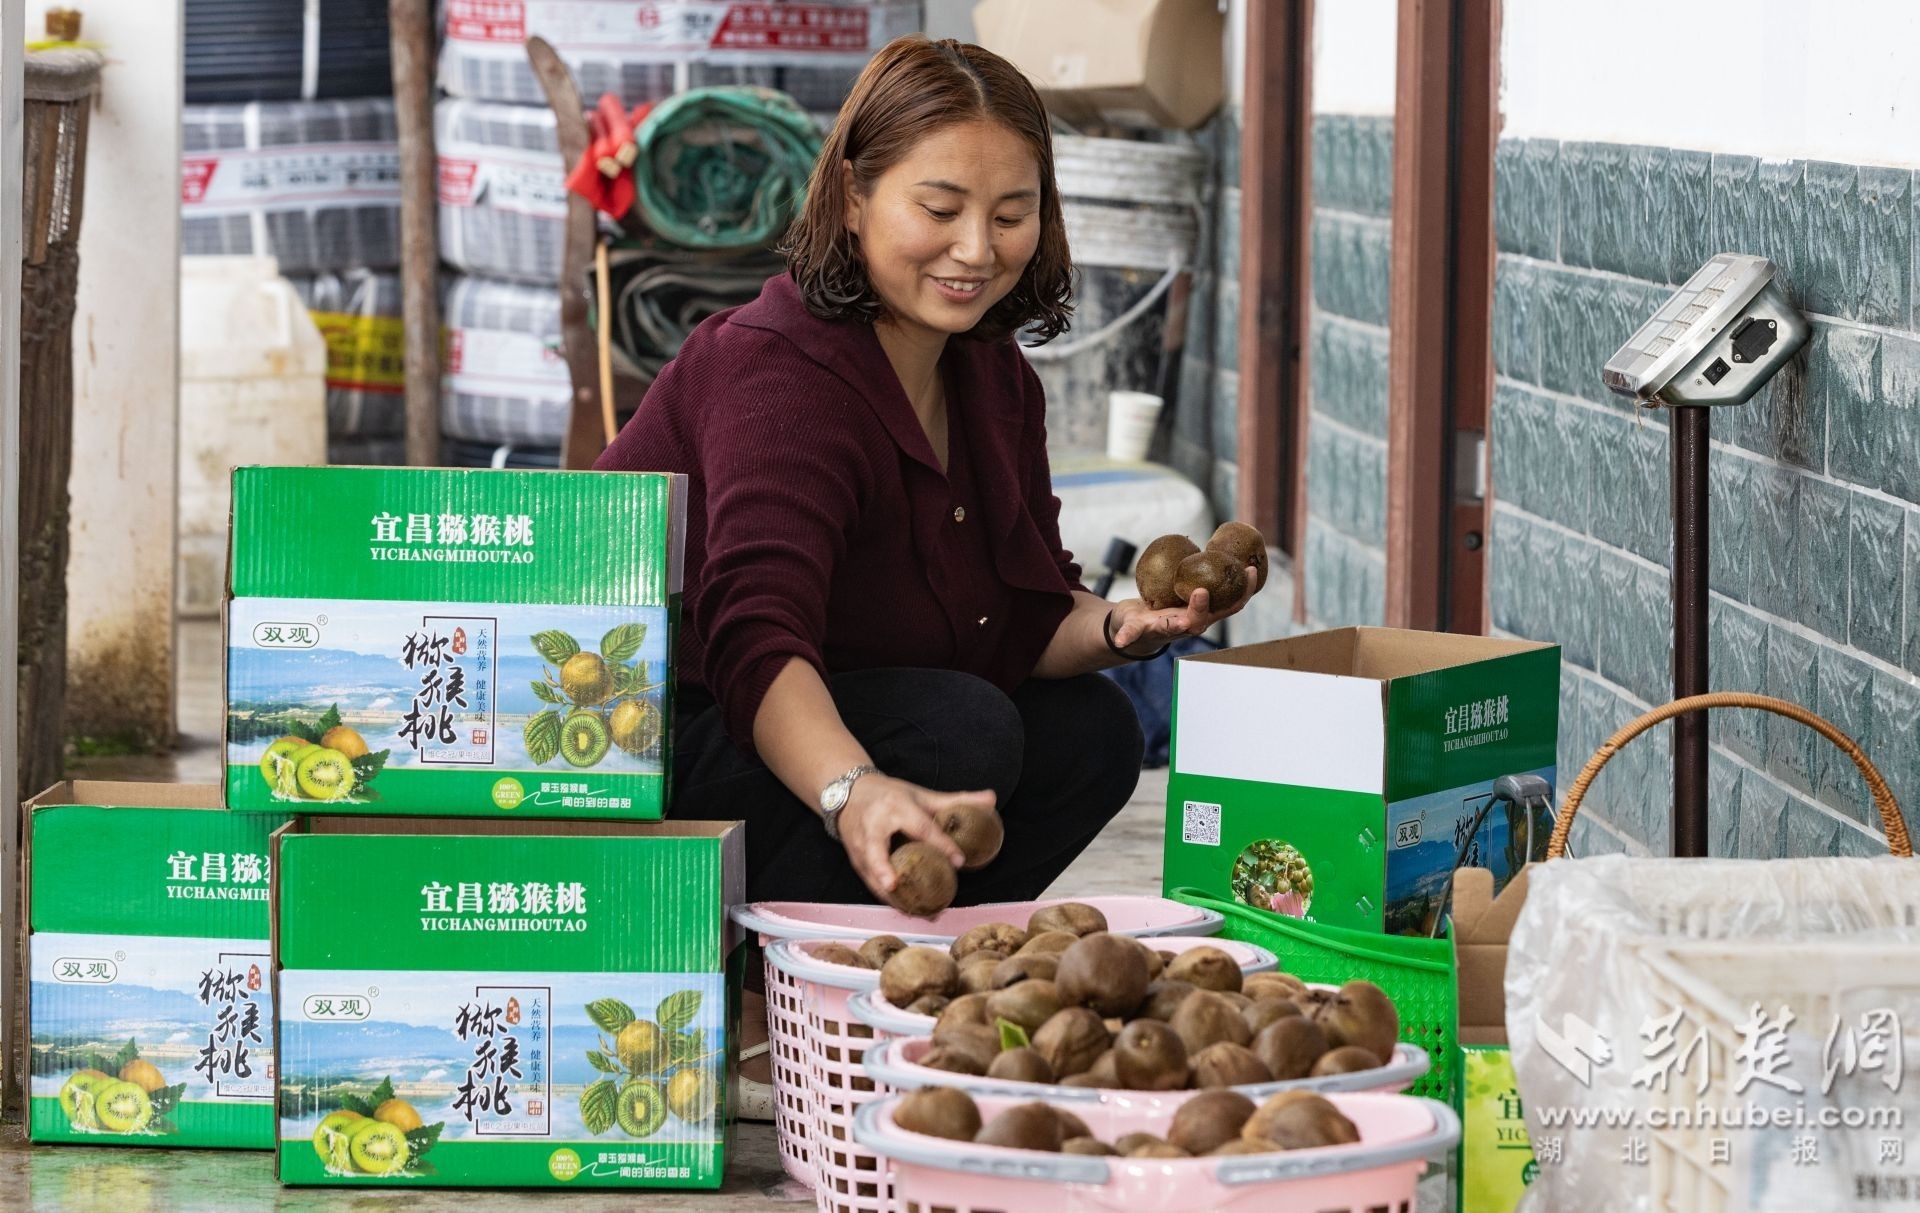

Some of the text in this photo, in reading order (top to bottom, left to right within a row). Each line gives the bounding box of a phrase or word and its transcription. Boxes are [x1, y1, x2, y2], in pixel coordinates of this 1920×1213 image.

[370, 512, 534, 546] 宜昌猕猴桃
[370, 548, 534, 563] YICHANGMIHOUTAO
[260, 626, 314, 644] 双观
[398, 628, 468, 750] 猕猴桃
[1444, 694, 1509, 735] 宜昌猕猴桃
[1444, 727, 1509, 752] YICHANGMIHOUTAO
[1398, 823, 1419, 842] 双观
[166, 850, 270, 884] 宜昌猕
[420, 881, 587, 915] 宜昌猕猴桃
[420, 918, 587, 932] YICHANGMIHOUTAO
[60, 962, 111, 979] 双观
[311, 999, 364, 1016] 双观
[194, 964, 262, 1084] 猕猴桃
[453, 1000, 522, 1122] 猕猴桃
